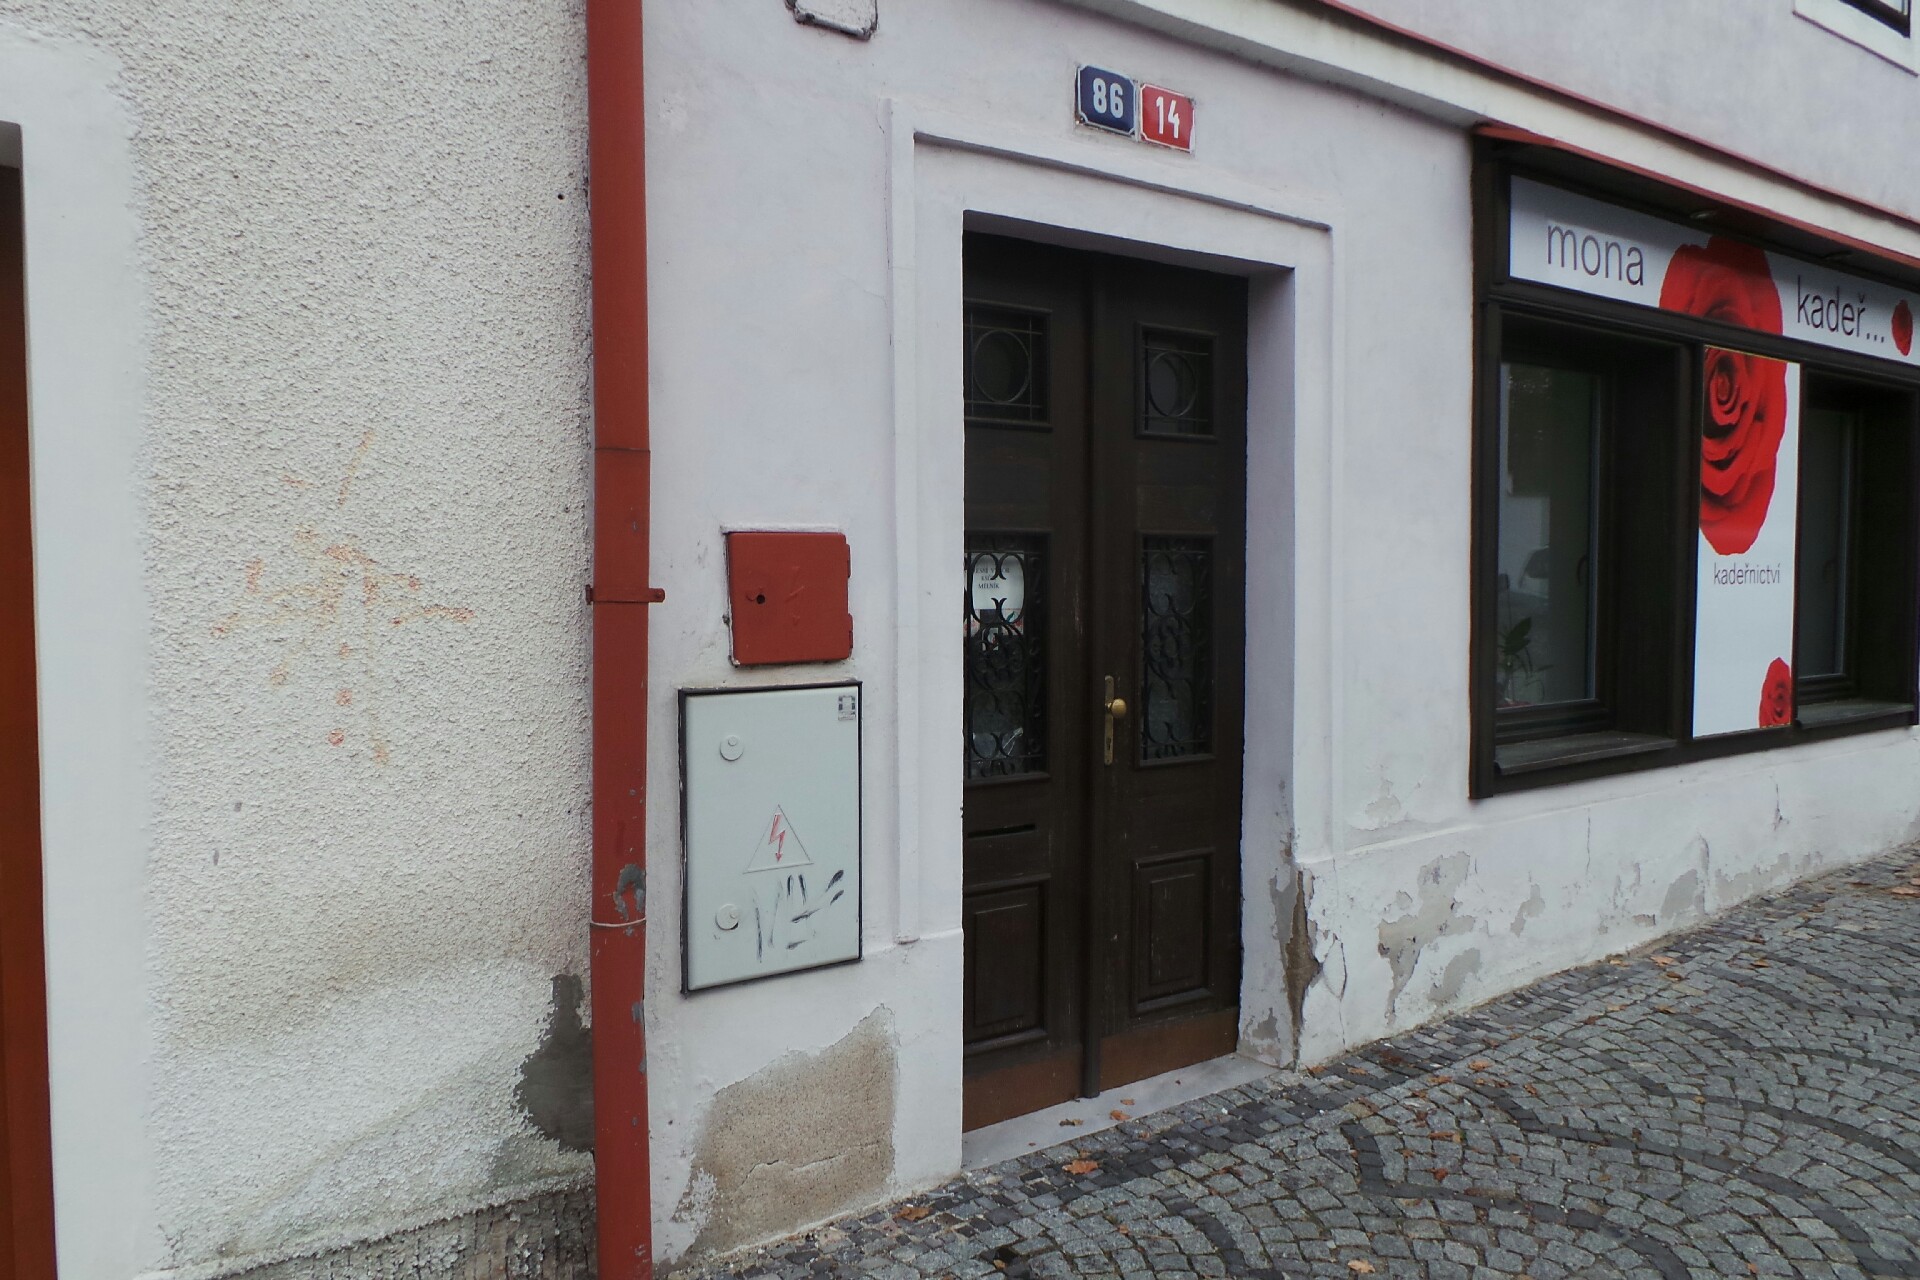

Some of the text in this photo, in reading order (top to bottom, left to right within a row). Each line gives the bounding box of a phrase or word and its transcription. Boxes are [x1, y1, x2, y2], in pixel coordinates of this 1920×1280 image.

[1092, 77, 1124, 119] 86
[1156, 95, 1180, 139] 14
[1547, 225, 1885, 343] mona kadeř...
[1713, 562, 1781, 585] kadeřnictví
